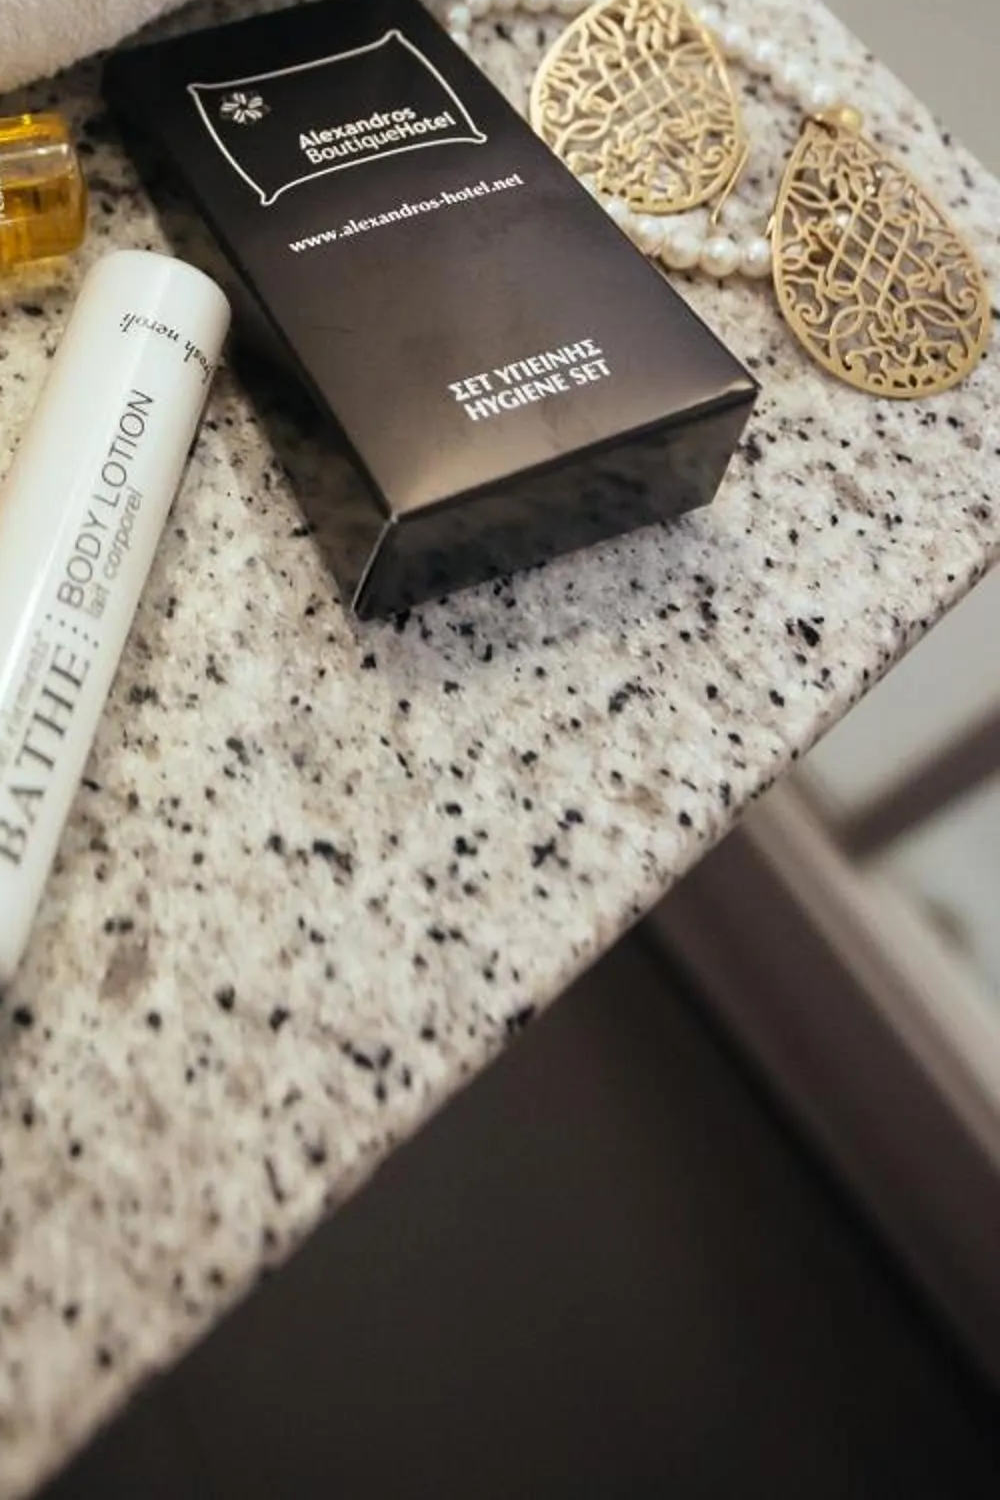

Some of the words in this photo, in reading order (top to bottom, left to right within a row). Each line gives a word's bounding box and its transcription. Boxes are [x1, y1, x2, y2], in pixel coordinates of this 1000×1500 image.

[299, 106, 417, 150] Alexandros
[305, 111, 457, 165] BoutiqueHotel
[289, 173, 524, 253] www.alexandros-hotel.net
[463, 373, 571, 421] HYGIENE
[568, 358, 611, 385] SET
[56, 508, 111, 610] BODY
[92, 388, 156, 510] LOTION
[102, 485, 144, 582] corporel
